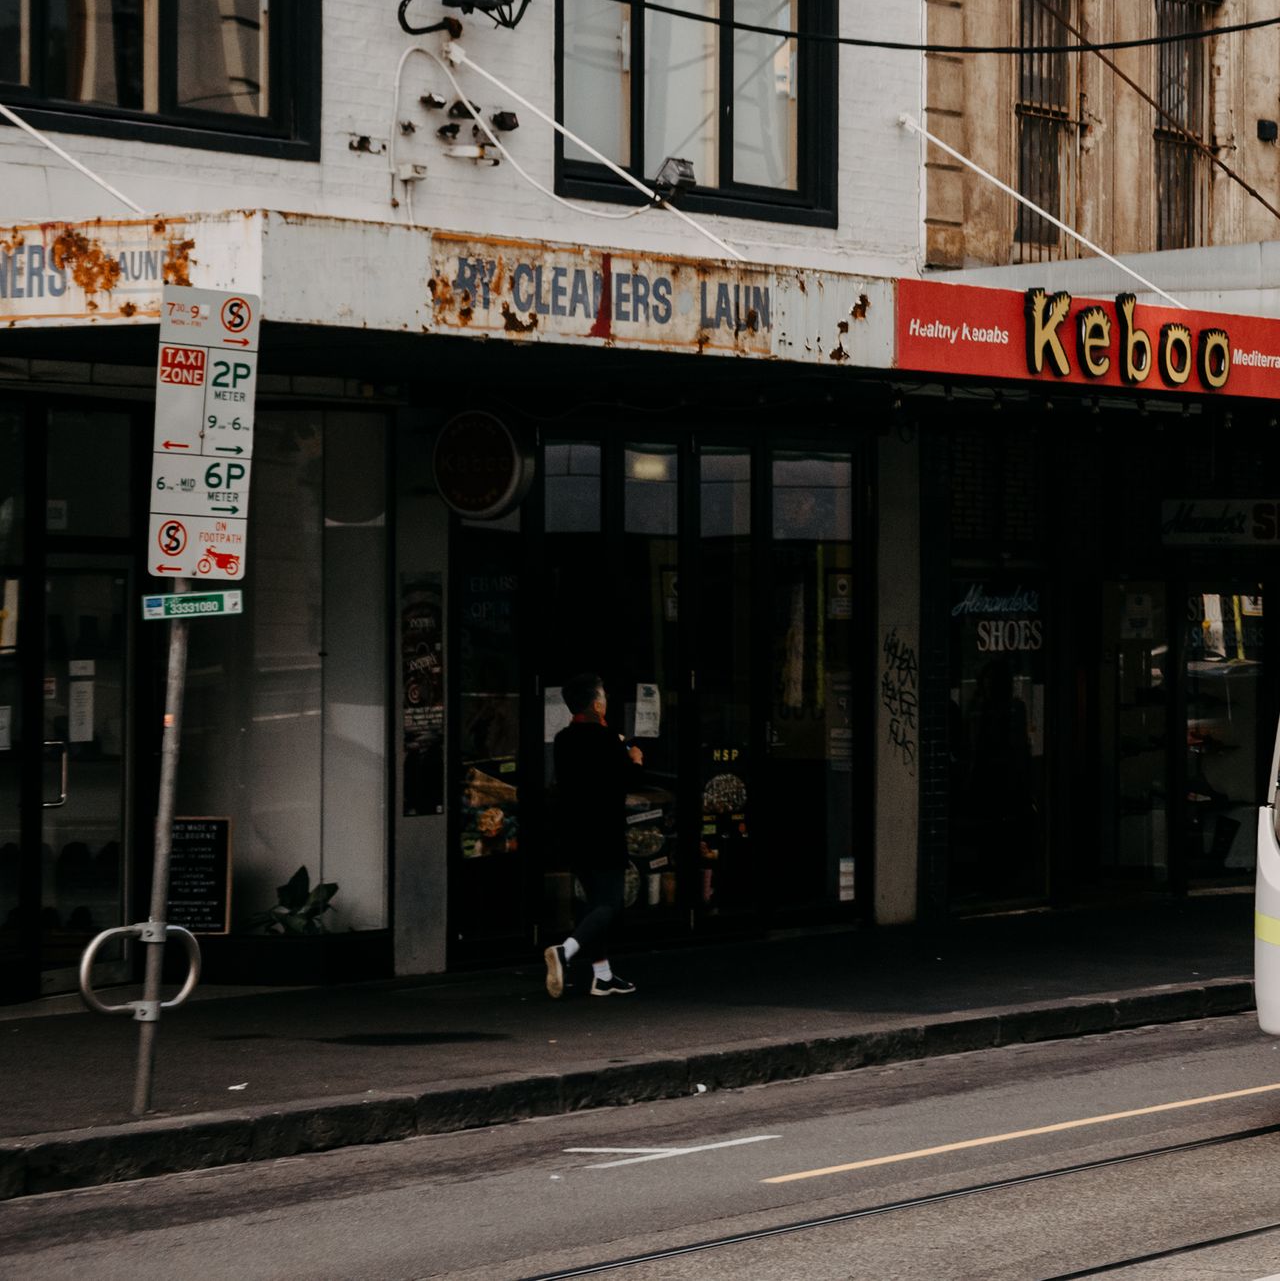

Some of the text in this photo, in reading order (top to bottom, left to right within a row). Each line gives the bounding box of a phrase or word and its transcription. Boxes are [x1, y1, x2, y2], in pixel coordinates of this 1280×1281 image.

[1026, 288, 1231, 391] Keboo
[165, 349, 202, 366] TAXI
[160, 366, 204, 385] ZONE
[211, 361, 251, 389] 2P
[214, 390, 246, 402] METER
[204, 462, 246, 490] 6P
[207, 491, 239, 503] METER
[216, 522, 227, 531] ON
[199, 532, 242, 543] FOOTPATH
[170, 601, 218, 614] 33331080
[952, 583, 1040, 617] Alexander's
[977, 620, 1043, 652] SHOES
